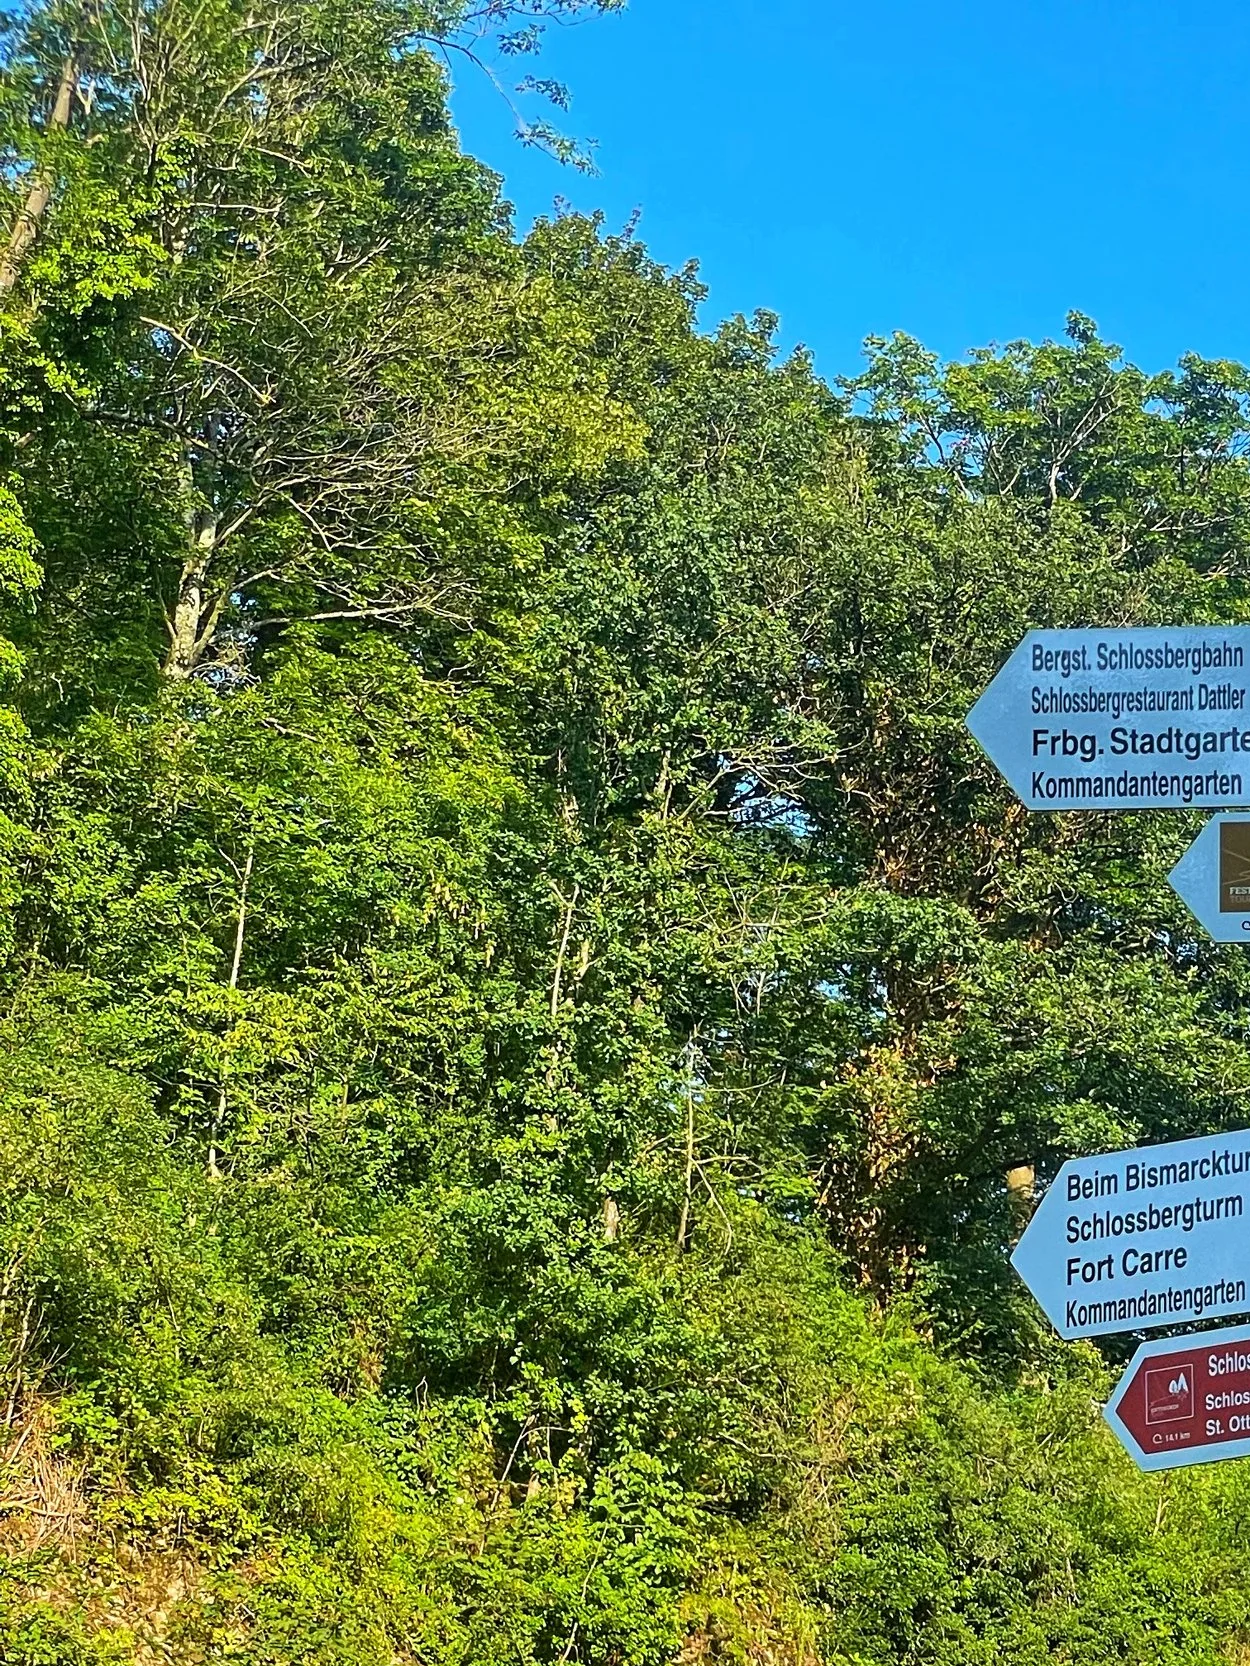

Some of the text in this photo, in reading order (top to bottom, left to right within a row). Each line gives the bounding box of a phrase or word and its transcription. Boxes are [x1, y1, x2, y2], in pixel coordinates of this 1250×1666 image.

[1032, 643, 1091, 678] Bergst.
[1097, 641, 1243, 675] Schlossbergbahn
[1031, 685, 1194, 719] Schlossbergrestaurant
[1198, 683, 1246, 710] Dattler
[1032, 728, 1104, 762] Frbg.
[1032, 770, 1242, 803] Kommandantengarten
[1067, 1170, 1118, 1201] Beim
[1066, 1194, 1243, 1244] Schlossbergturm
[1067, 1256, 1114, 1286] Fort
[1122, 1246, 1188, 1275] Carre
[1066, 1278, 1246, 1328] Kommandantengarten
[1205, 1418, 1225, 1436] St.
